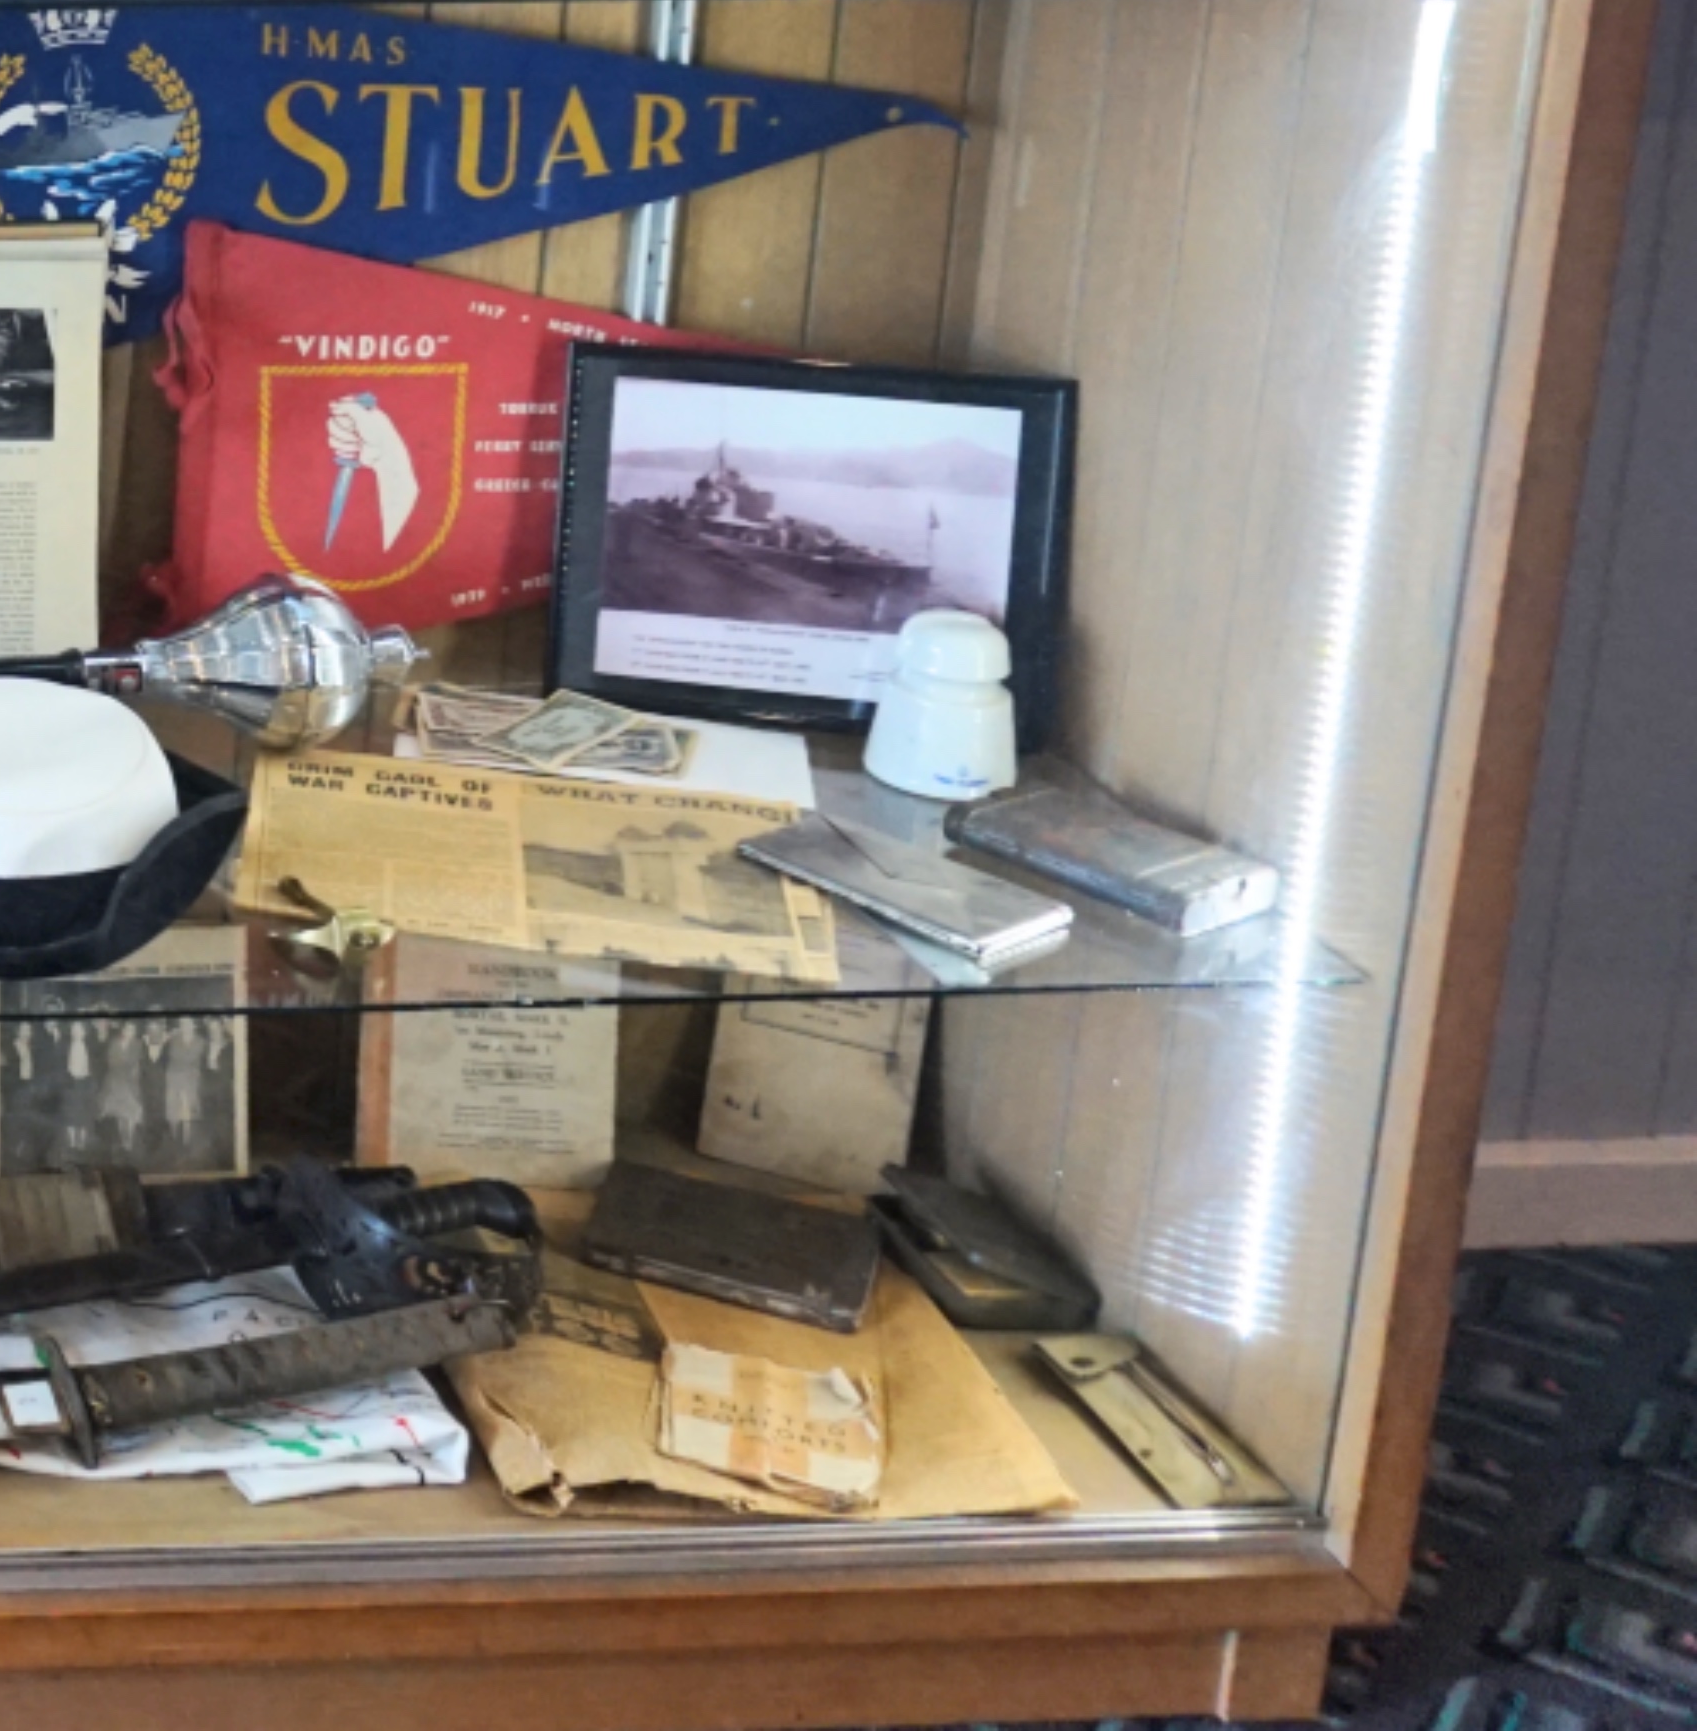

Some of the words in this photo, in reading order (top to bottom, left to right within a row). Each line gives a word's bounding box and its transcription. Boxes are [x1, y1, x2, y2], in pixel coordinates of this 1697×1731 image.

[254, 80, 756, 225] STUART
[287, 773, 344, 791] WAR
[365, 783, 494, 811] CAPTIVES
[288, 760, 354, 778] GRIM
[461, 778, 492, 794] OF
[535, 782, 639, 805] WHAT
